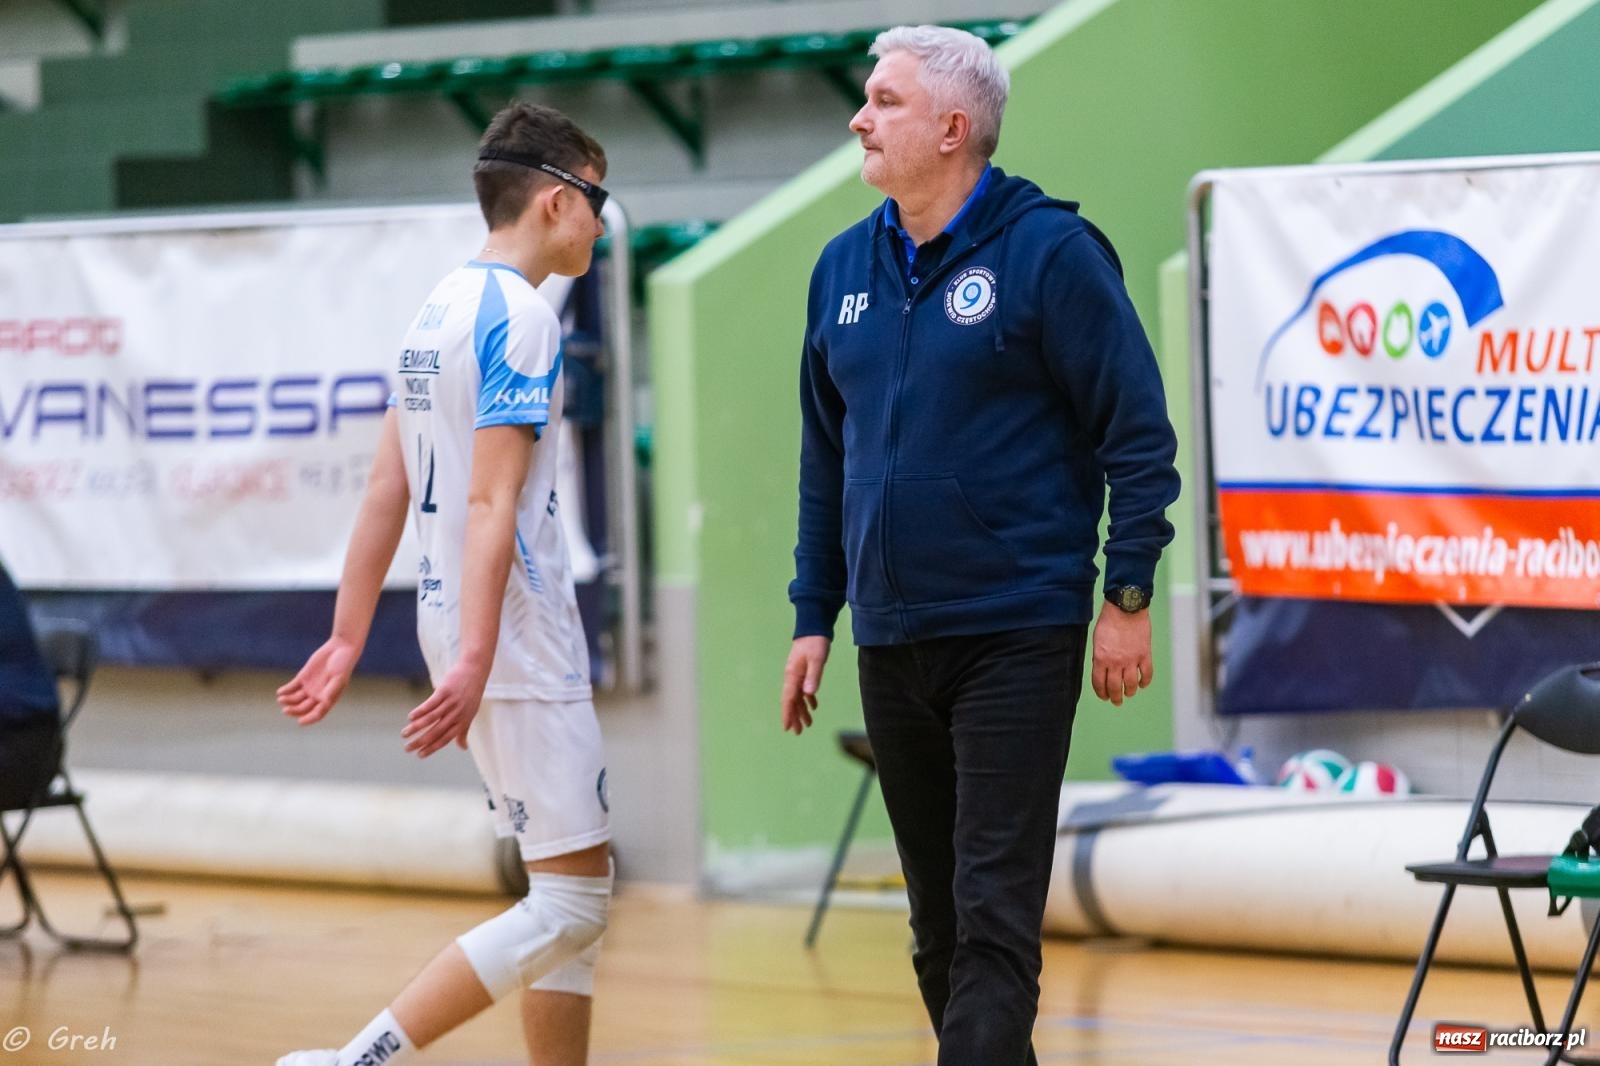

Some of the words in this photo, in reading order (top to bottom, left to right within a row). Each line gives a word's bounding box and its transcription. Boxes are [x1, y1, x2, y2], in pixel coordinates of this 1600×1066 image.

[953, 272, 968, 286] KLUB
[968, 269, 996, 285] SPORTOWY
[837, 292, 869, 325] RP
[946, 291, 957, 319] NORWID
[960, 281, 982, 310] 9
